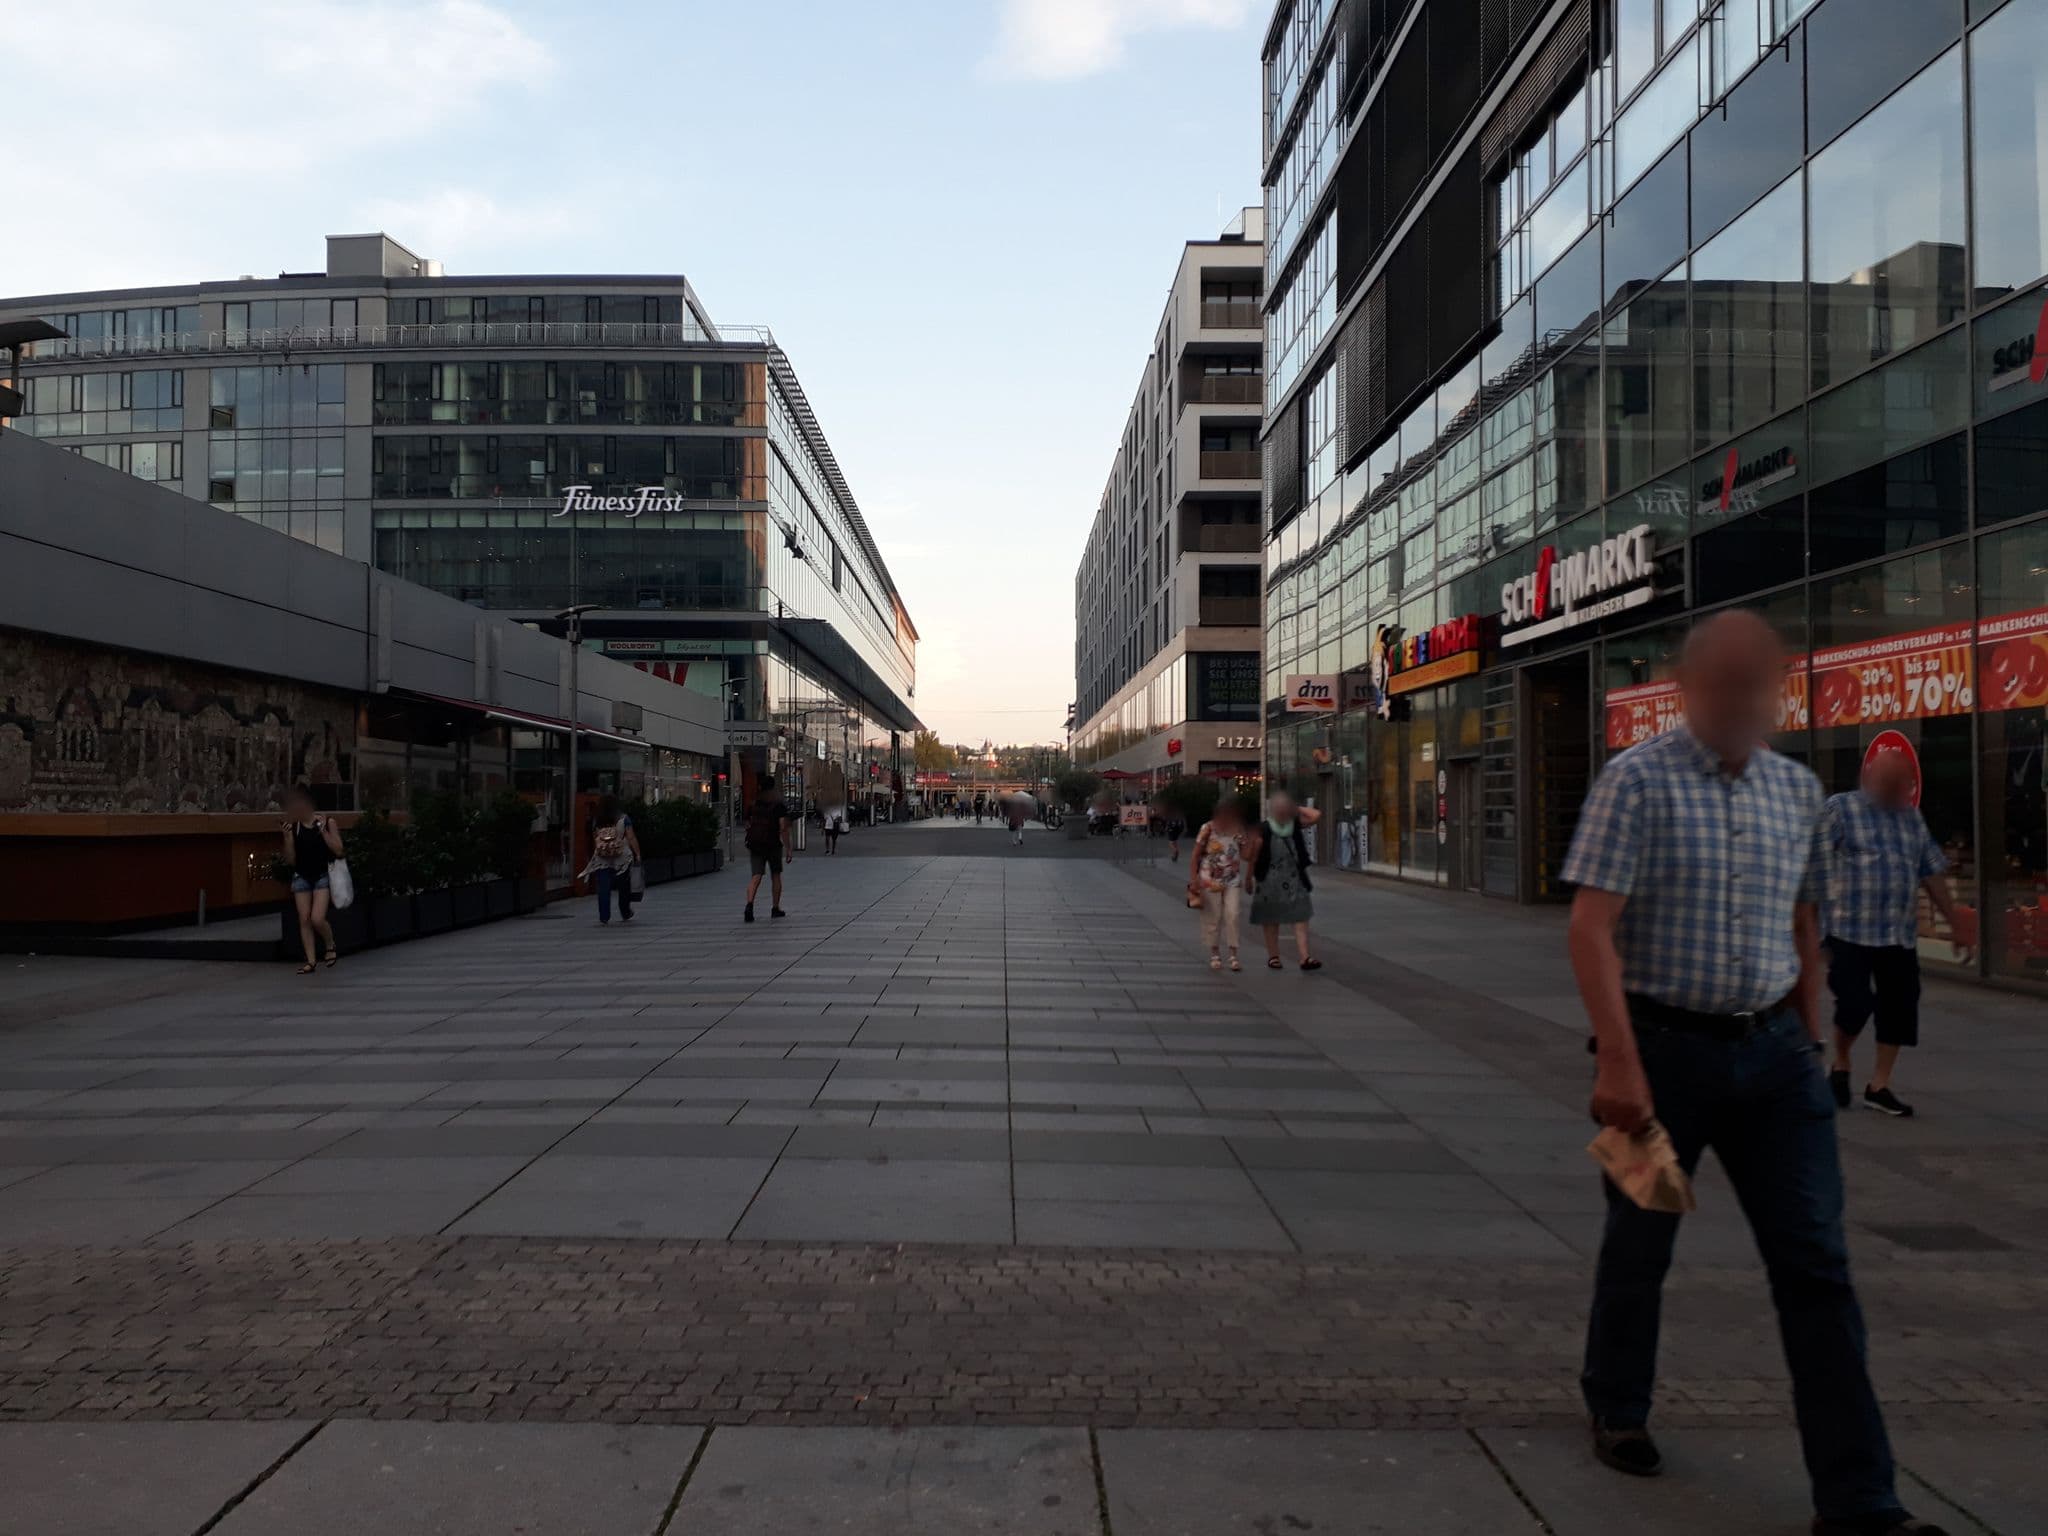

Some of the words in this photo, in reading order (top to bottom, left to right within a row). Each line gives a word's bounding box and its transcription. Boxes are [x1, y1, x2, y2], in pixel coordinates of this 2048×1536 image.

[1904, 656, 1923, 675] bis
[1925, 658, 1941, 672] zu
[1861, 666, 1894, 687] 30%
[1298, 680, 1328, 698] dm
[1904, 671, 1973, 713] 70%
[1860, 691, 1902, 718] 50%
